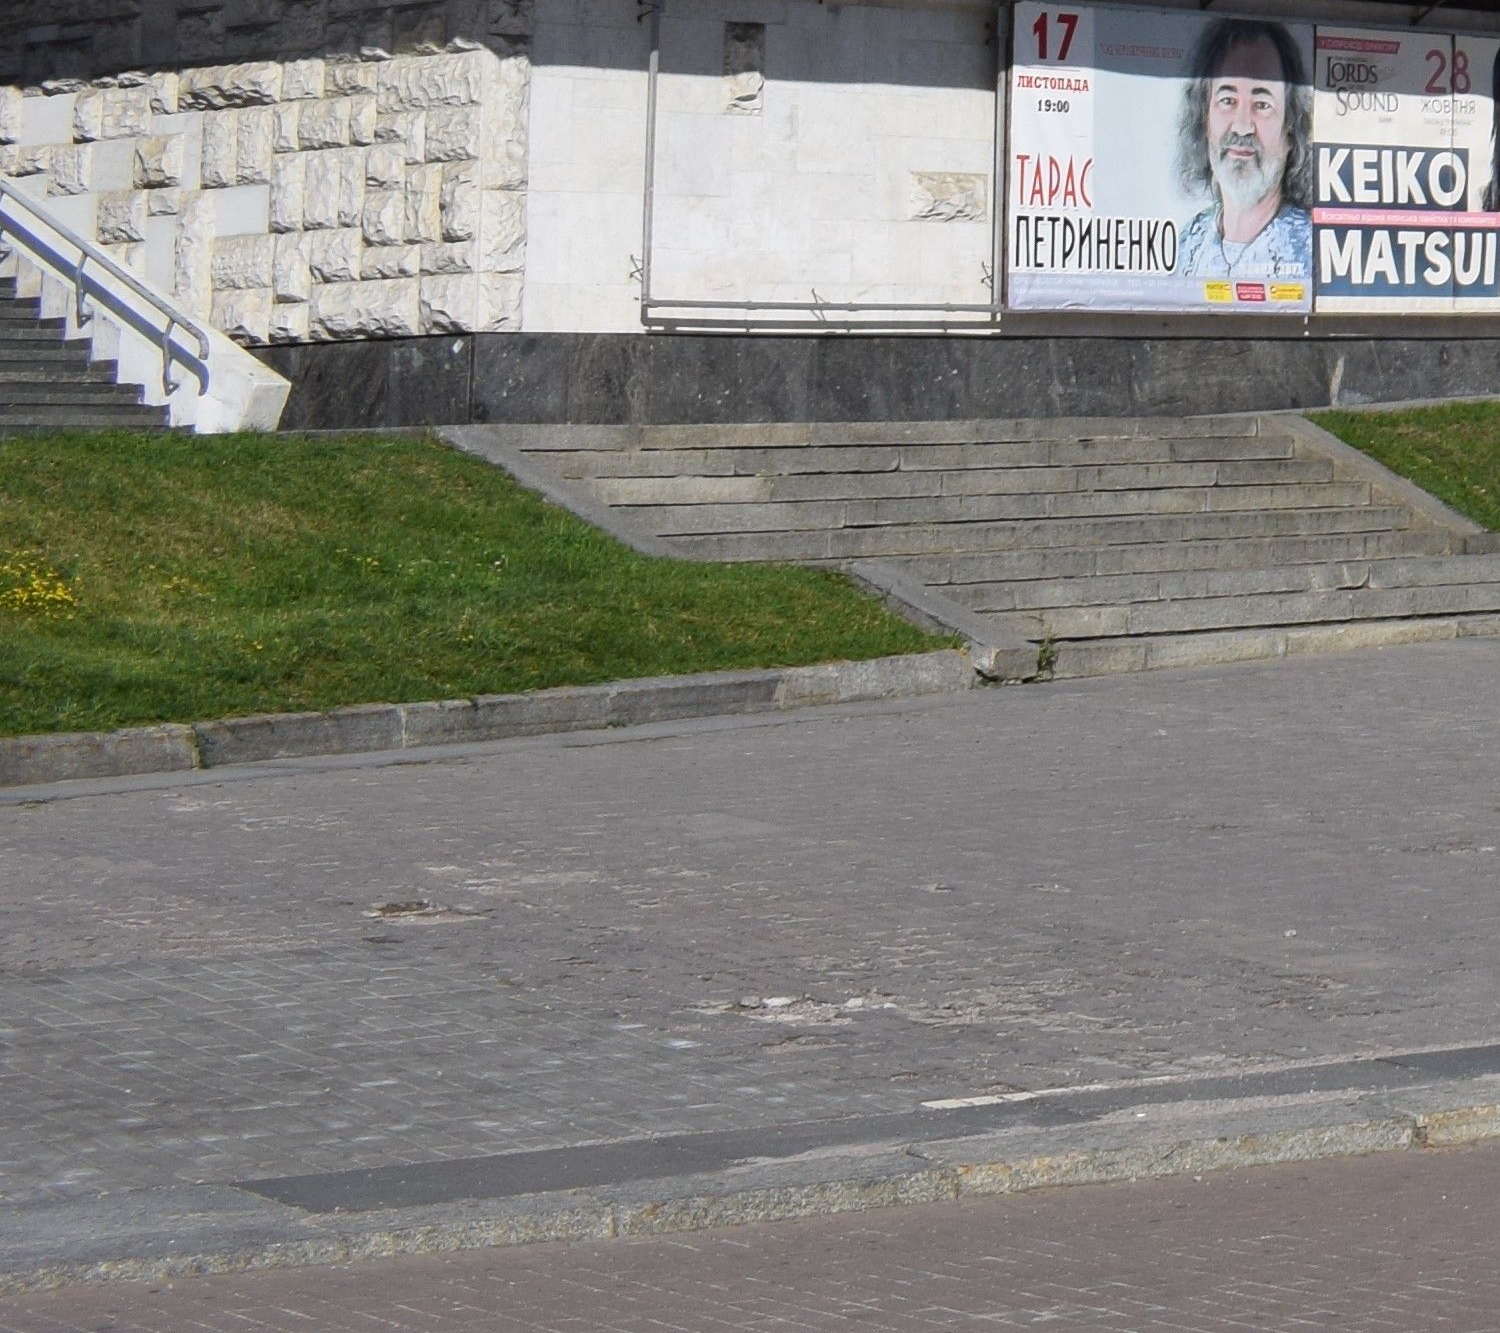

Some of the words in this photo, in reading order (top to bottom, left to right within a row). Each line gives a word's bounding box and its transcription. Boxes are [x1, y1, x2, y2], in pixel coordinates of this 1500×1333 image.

[1033, 12, 1079, 60] 17
[1017, 75, 1089, 92] ЛИСТОПАДА
[1425, 49, 1472, 95] 28
[1037, 99, 1070, 113] 19:00
[1421, 99, 1476, 114] ЖОВТНЯ
[1016, 153, 1093, 208] ТАРАС
[1318, 147, 1467, 206] KEIKO
[1016, 215, 1177, 272] ПЕТРИНЕНКО
[1319, 228, 1497, 285] MATSUI
